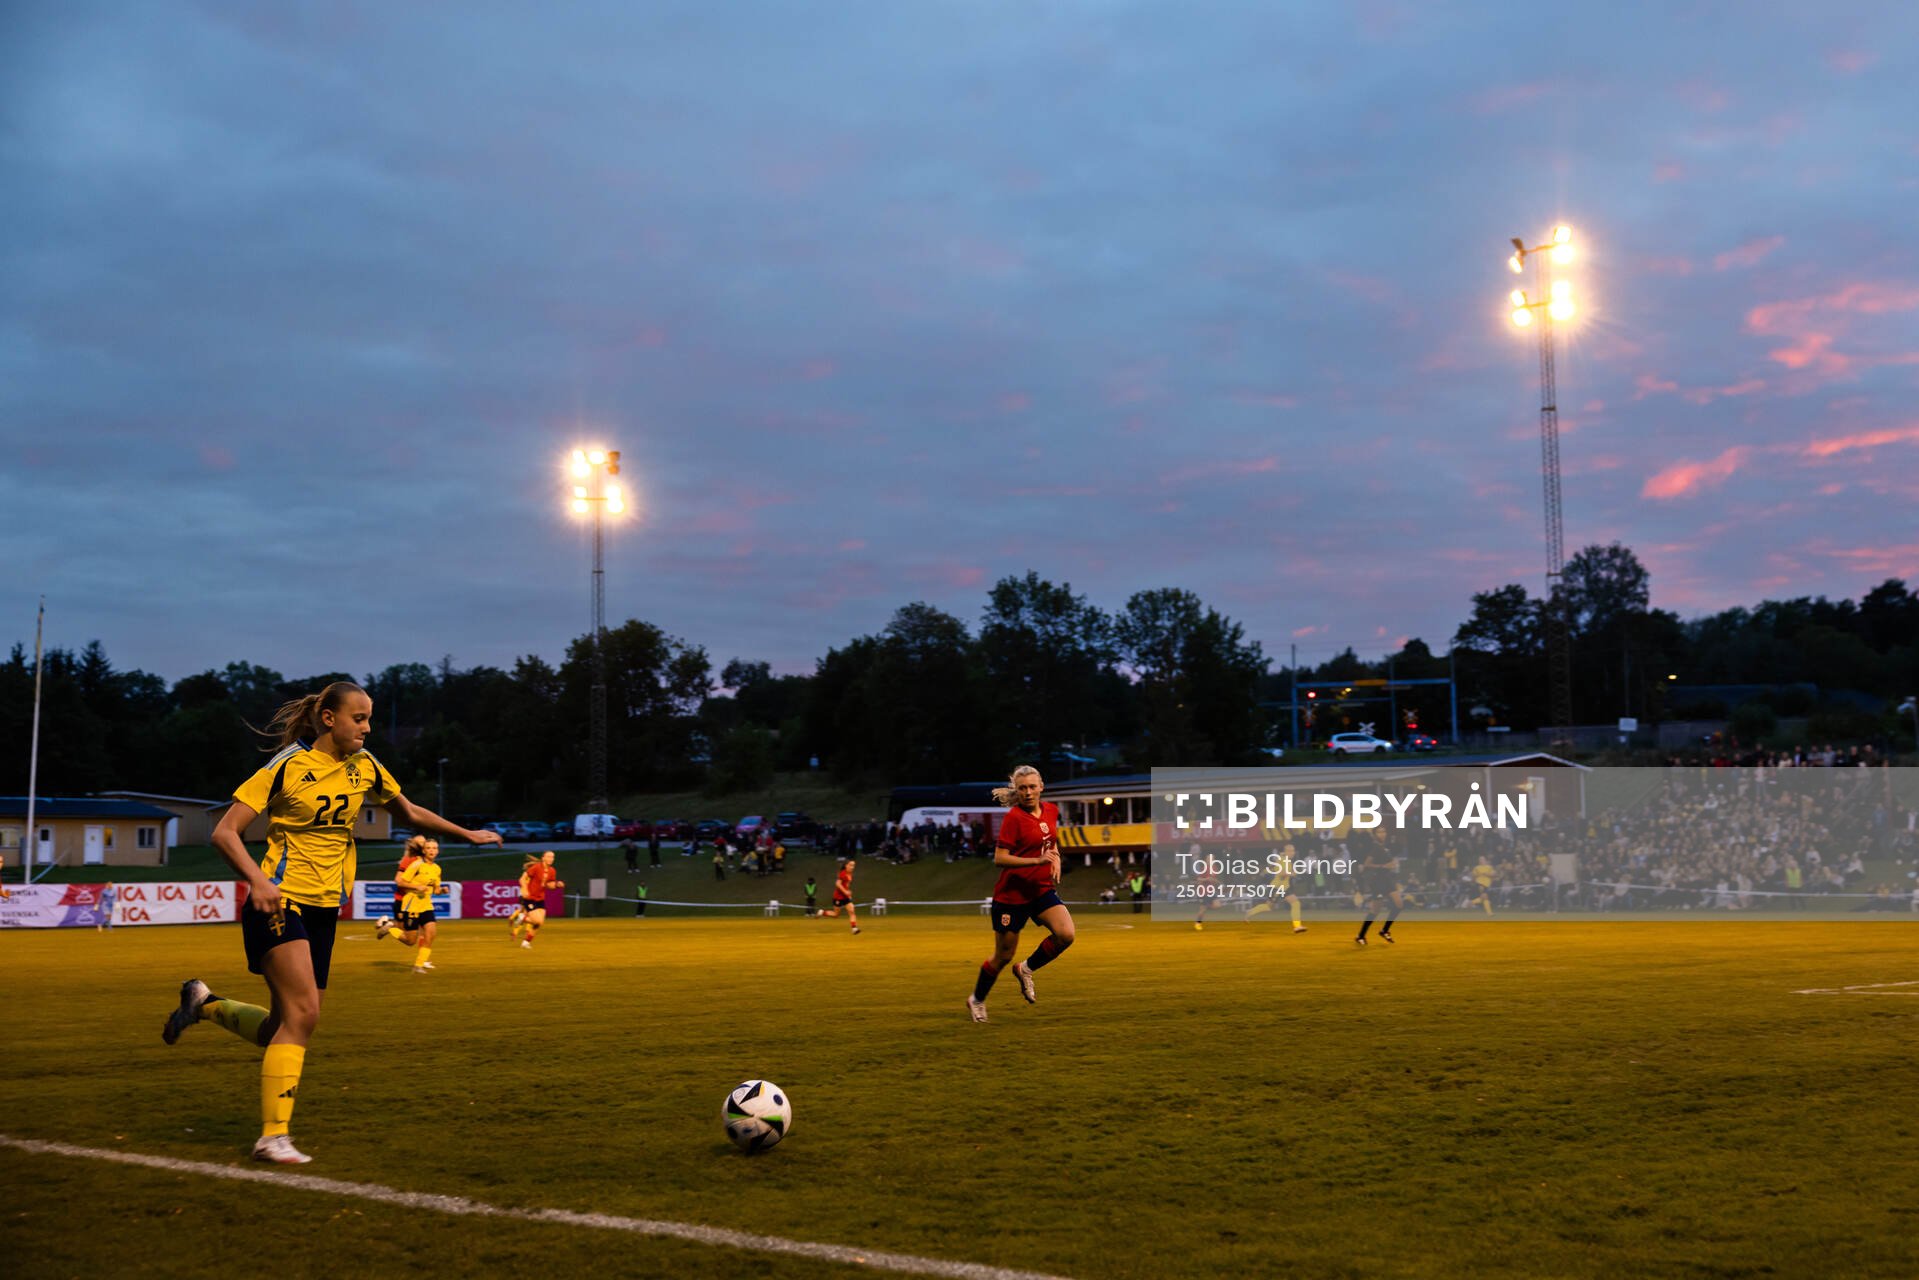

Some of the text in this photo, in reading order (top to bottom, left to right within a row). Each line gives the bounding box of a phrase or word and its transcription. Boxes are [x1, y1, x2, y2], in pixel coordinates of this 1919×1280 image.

[313, 794, 349, 825] 22
[117, 885, 224, 901] ICA ICA ICA
[122, 905, 221, 921] ICA ICA
